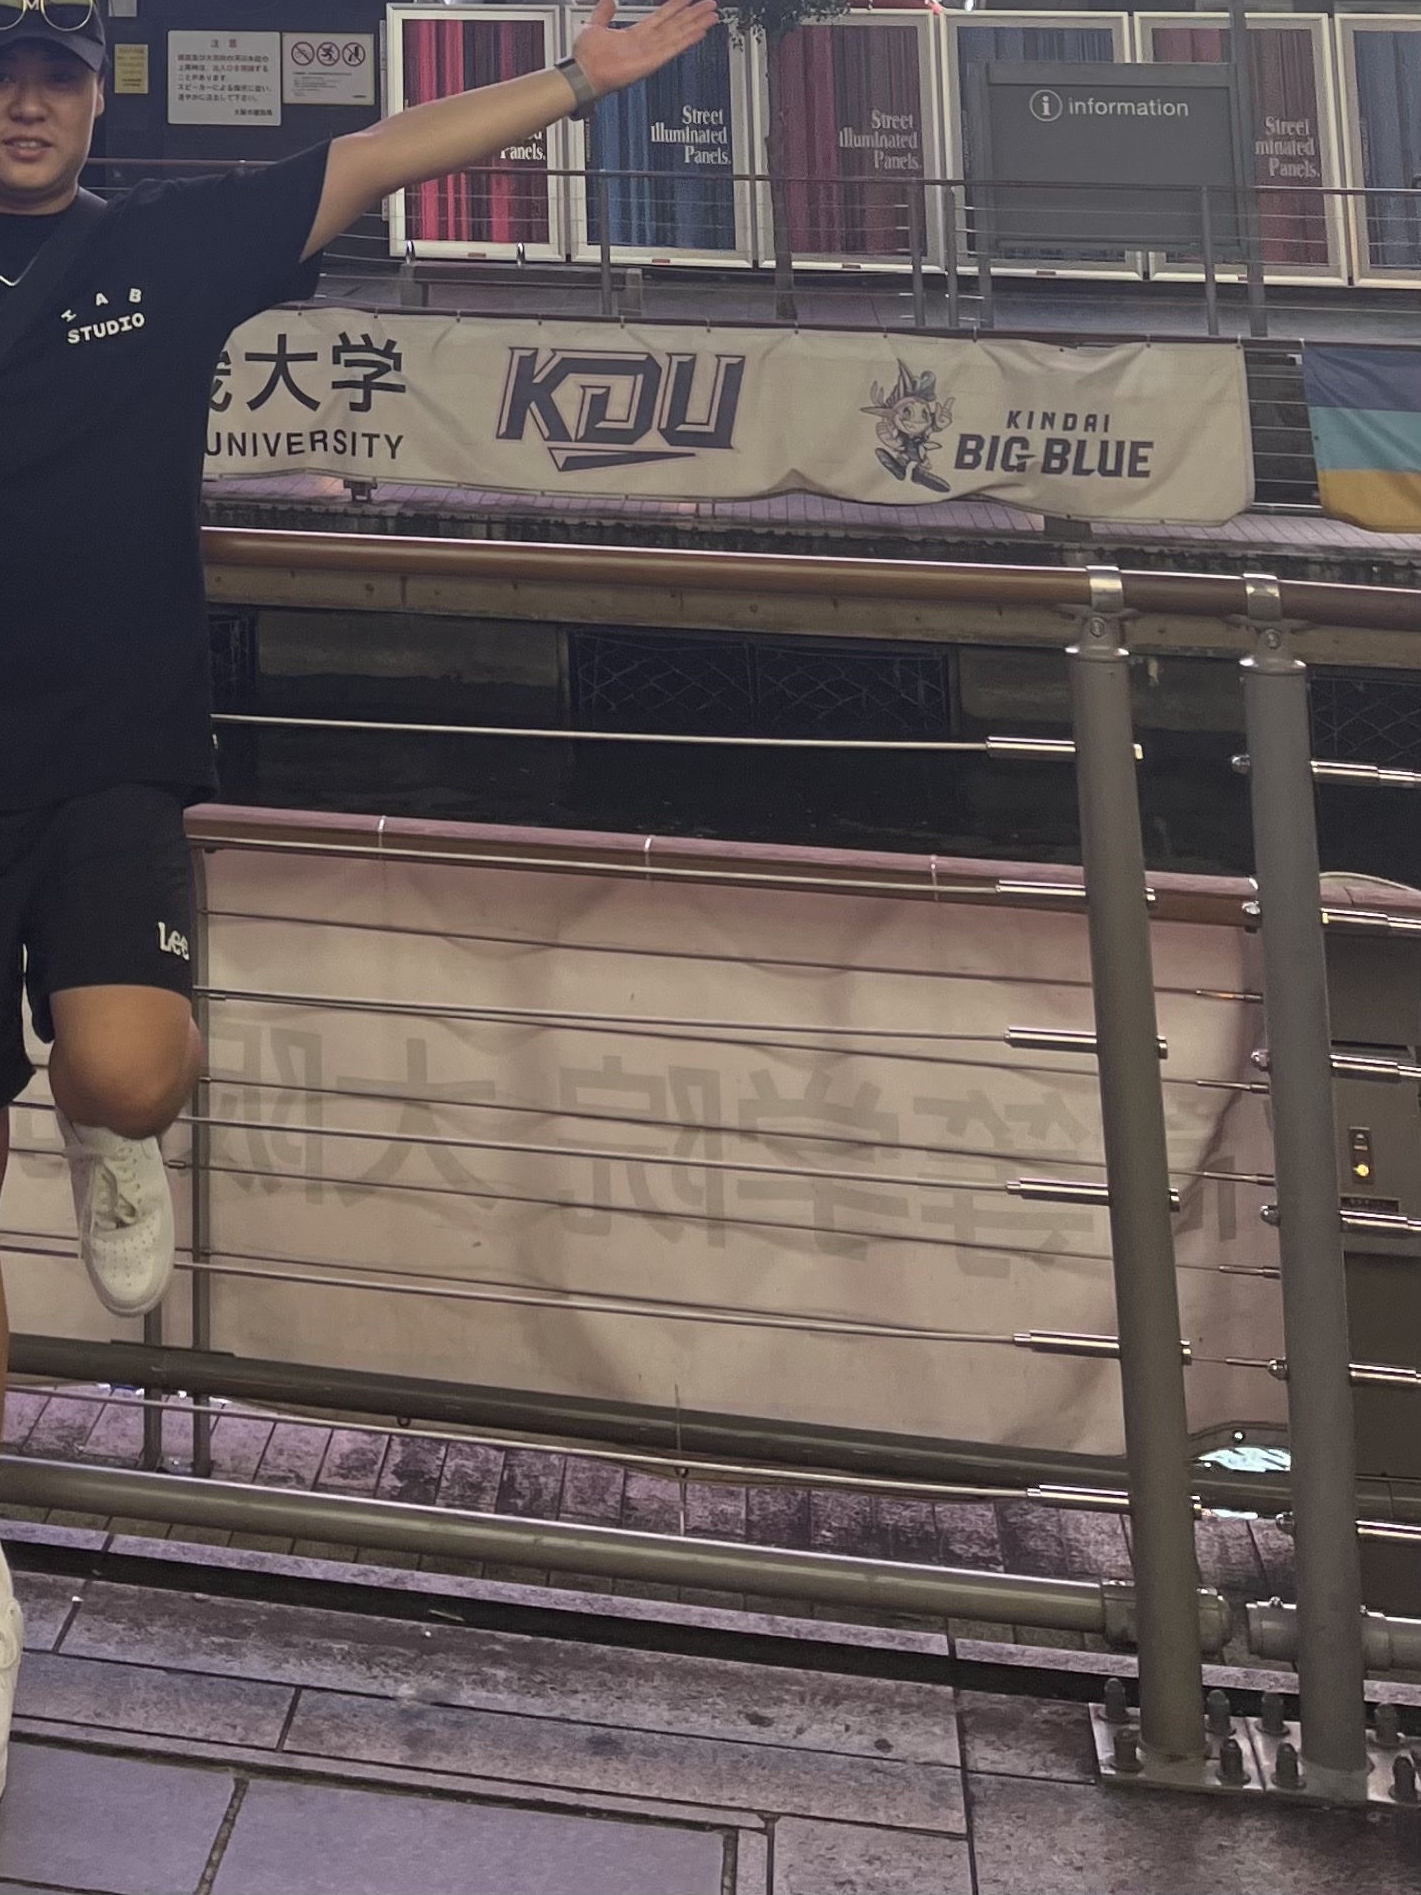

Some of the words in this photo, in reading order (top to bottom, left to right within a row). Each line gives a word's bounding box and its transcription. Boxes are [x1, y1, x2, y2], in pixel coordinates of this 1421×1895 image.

[682, 104, 724, 125] Street
[1068, 96, 1190, 117] information
[871, 109, 914, 129] Street
[1265, 116, 1310, 136] Street
[650, 121, 728, 145] Illuminated
[840, 127, 918, 149] Illuminated
[684, 145, 732, 166] Panels.
[1269, 158, 1321, 178] Panels.
[67, 312, 145, 344] STUDIO
[496, 347, 746, 449] KDU
[1006, 410, 1110, 433] KINDAI
[205, 428, 404, 460] UNIVERSITY
[954, 433, 1036, 473] BIG
[1041, 438, 1155, 478] BLUE
[158, 921, 190, 960] Lee
